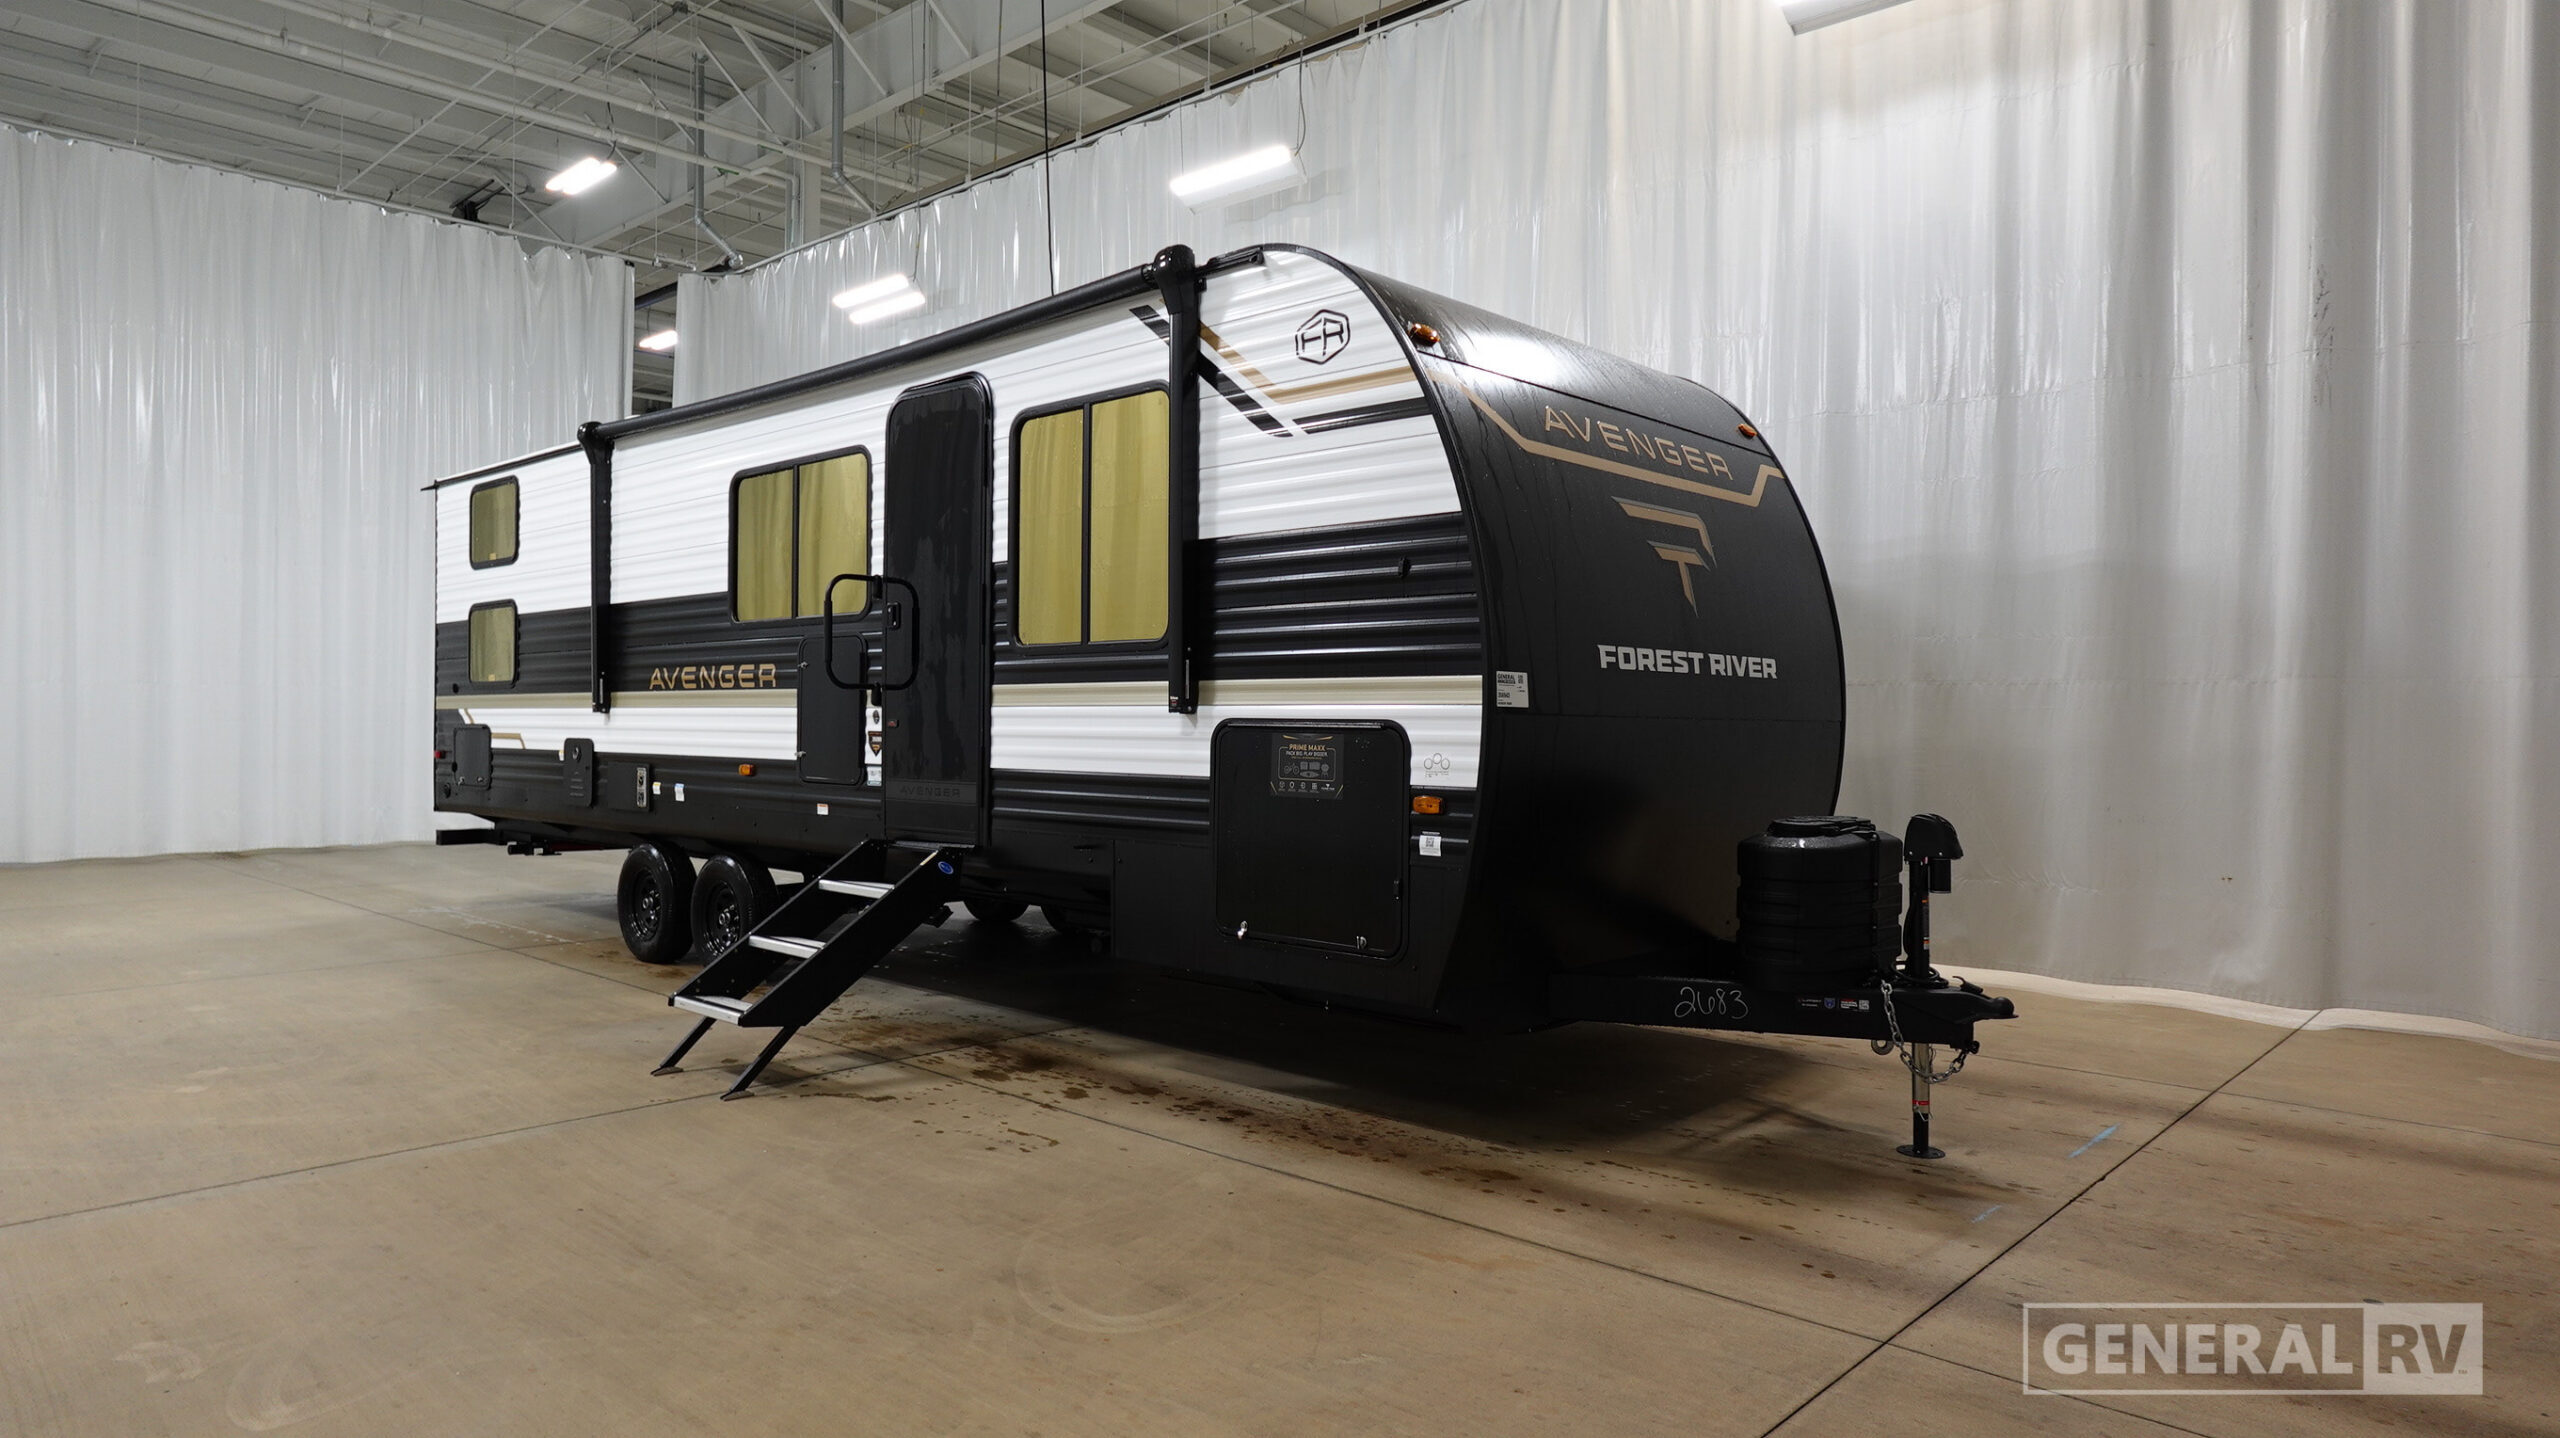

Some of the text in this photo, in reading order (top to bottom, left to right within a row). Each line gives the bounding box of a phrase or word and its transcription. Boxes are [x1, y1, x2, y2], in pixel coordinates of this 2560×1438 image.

[1545, 405, 1734, 481] AVENGER
[649, 663, 776, 690] AVENGER
[1597, 644, 1778, 680] FOREST RIVER
[900, 785, 960, 798] AVENGER
[1674, 986, 1749, 1020] 2683
